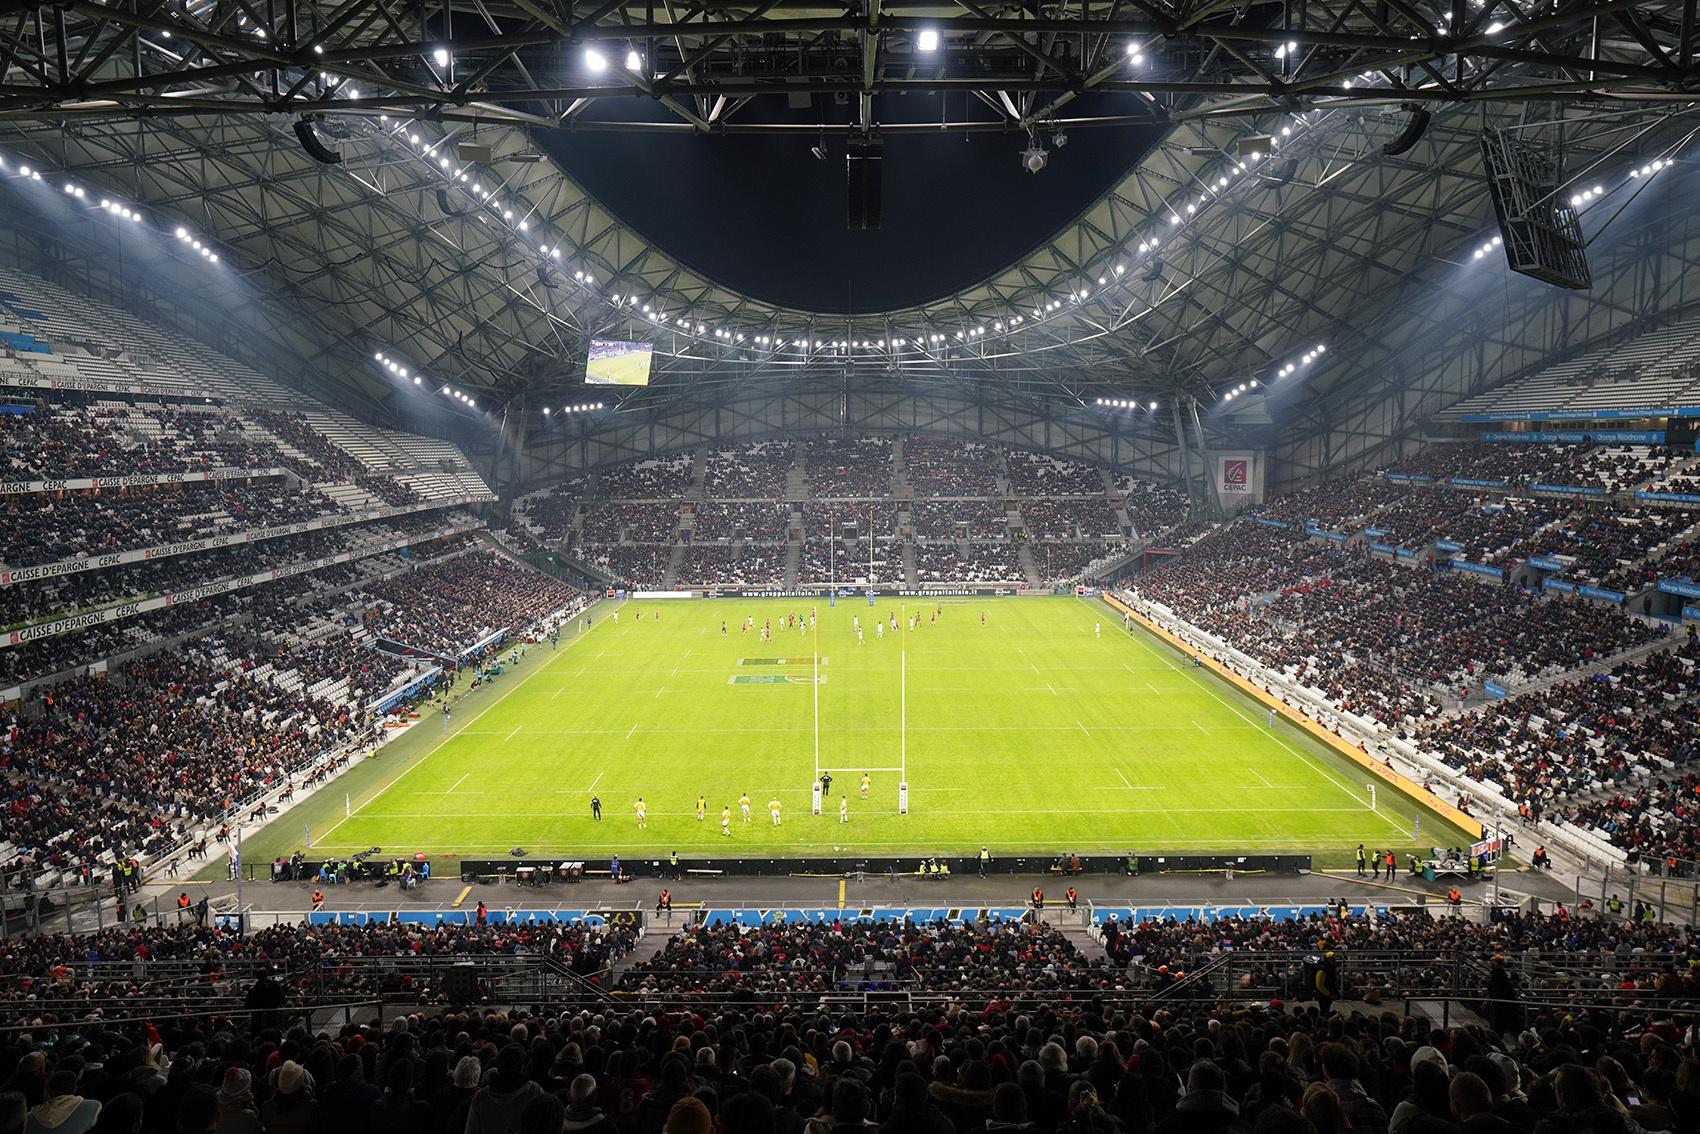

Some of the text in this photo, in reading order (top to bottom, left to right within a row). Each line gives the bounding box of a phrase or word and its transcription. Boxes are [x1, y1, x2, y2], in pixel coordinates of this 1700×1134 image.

[43, 480, 67, 490] CEPAC
[98, 473, 184, 486] CAISSE D'EPARGNE CEPAC
[151, 537, 229, 557] CAISSE D'EPARGNE CEPAC
[10, 555, 121, 581] CAISSE D'EPARGNE CEPAC
[172, 590, 194, 603] CAISSE
[237, 576, 254, 587] CEPAC
[20, 604, 140, 640] CAISSE D'EPARGNE CEPAC
